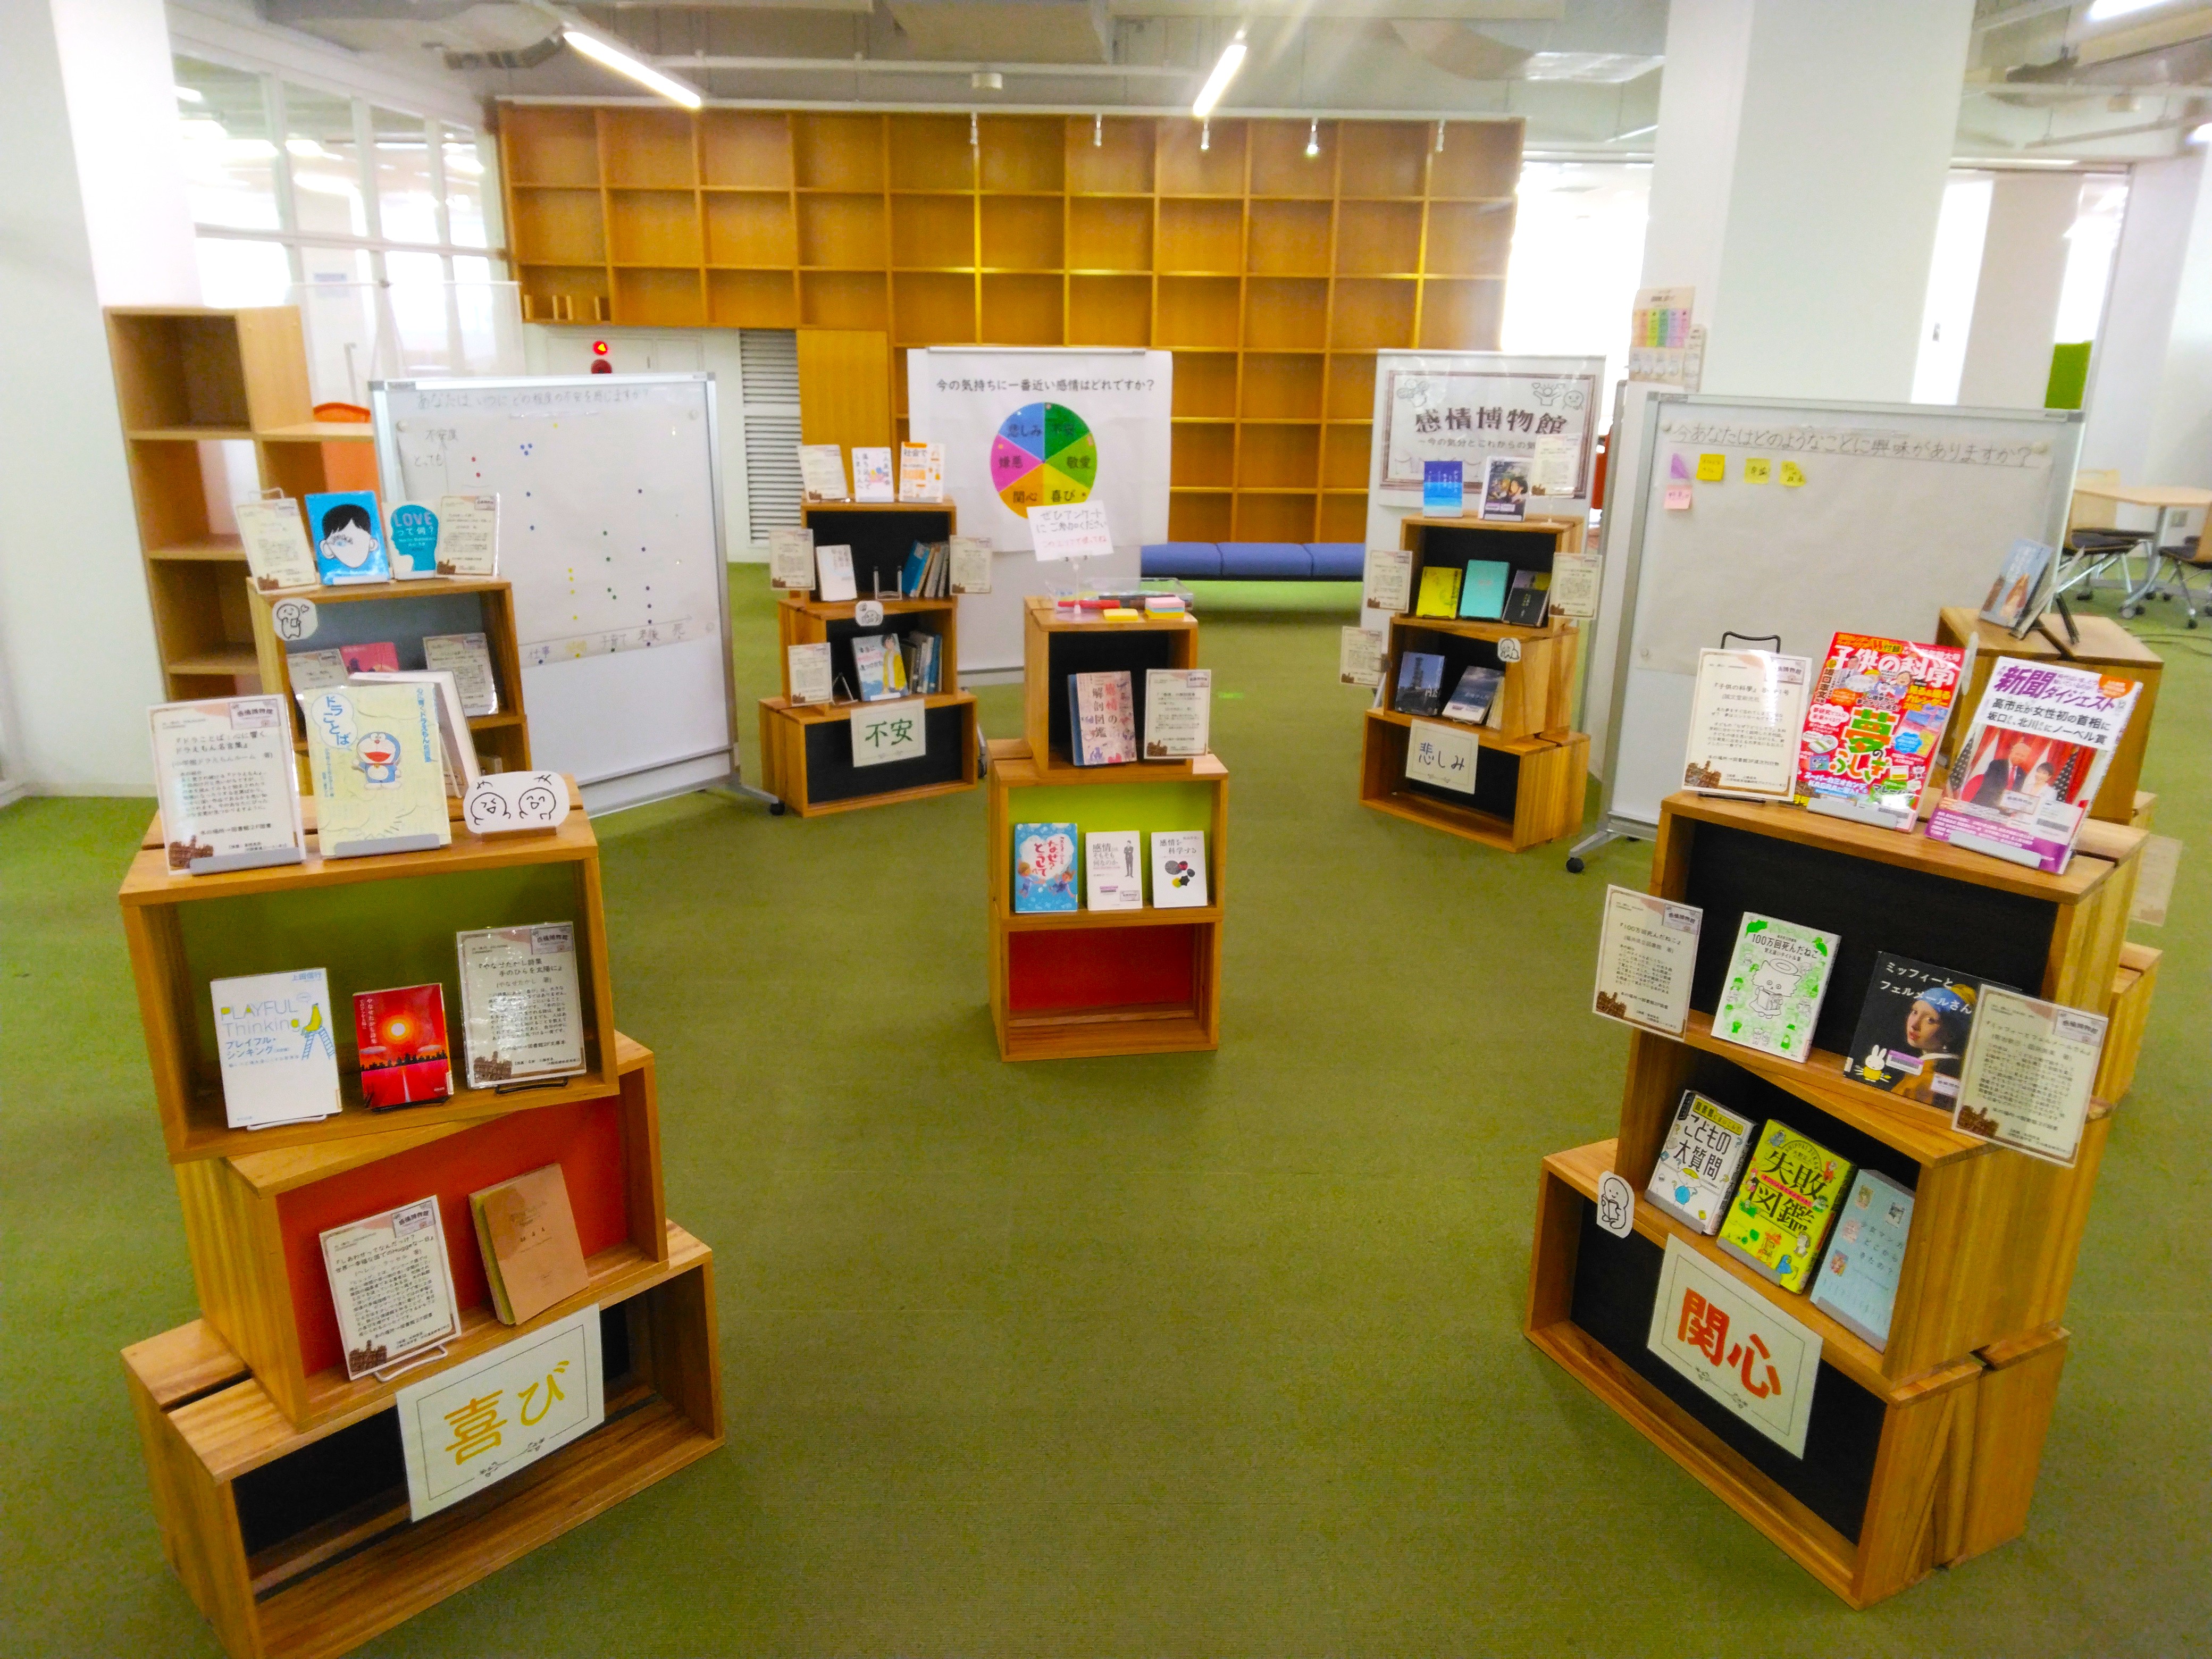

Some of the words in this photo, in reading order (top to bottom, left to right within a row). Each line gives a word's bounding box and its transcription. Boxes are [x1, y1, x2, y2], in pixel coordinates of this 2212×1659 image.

[937, 379, 1154, 392] 今の気持ちに一番近い感情はどれですか？
[1007, 425, 1042, 438] 悲しみ
[1051, 425, 1075, 437] 不安
[1415, 406, 1568, 435] 感情博物館
[1674, 424, 2033, 467] 今あなたはどのようなことに興味がありますか？
[999, 456, 1024, 470] 嫌悪
[1067, 456, 1091, 470] 敬愛
[1013, 490, 1038, 504] 関心
[1051, 489, 1076, 503] 喜び
[393, 511, 433, 527] LOVE
[1040, 508, 1102, 521] ぜひアンケート
[1831, 644, 1957, 688] 子供の科学
[1994, 665, 2116, 713] 新聞ダイジェスト
[323, 695, 350, 746] ドラことば
[1092, 687, 1107, 738] 解剖図鑑
[1992, 697, 2112, 731] 高市氏が女性初の首相に
[865, 717, 914, 748] 不安
[1418, 742, 1465, 771] 悲しみ
[1830, 750, 1891, 782] ふしぎ
[1752, 933, 1820, 959] 100万回死んだねこ
[1886, 961, 1953, 988] ミッフィーと
[221, 999, 299, 1021] PLAYFUL
[1879, 979, 1972, 1015] フェルメールさん
[223, 1019, 300, 1037] Thinking
[227, 1047, 273, 1060] シンキング
[1684, 1113, 1732, 1155] こどもの
[1673, 1139, 1723, 1181] 大質問
[1759, 1150, 1828, 1200] 失敗
[1748, 1176, 1815, 1232] 図鑑
[1678, 1287, 1782, 1399] 関心
[444, 1359, 569, 1466] 喜び
